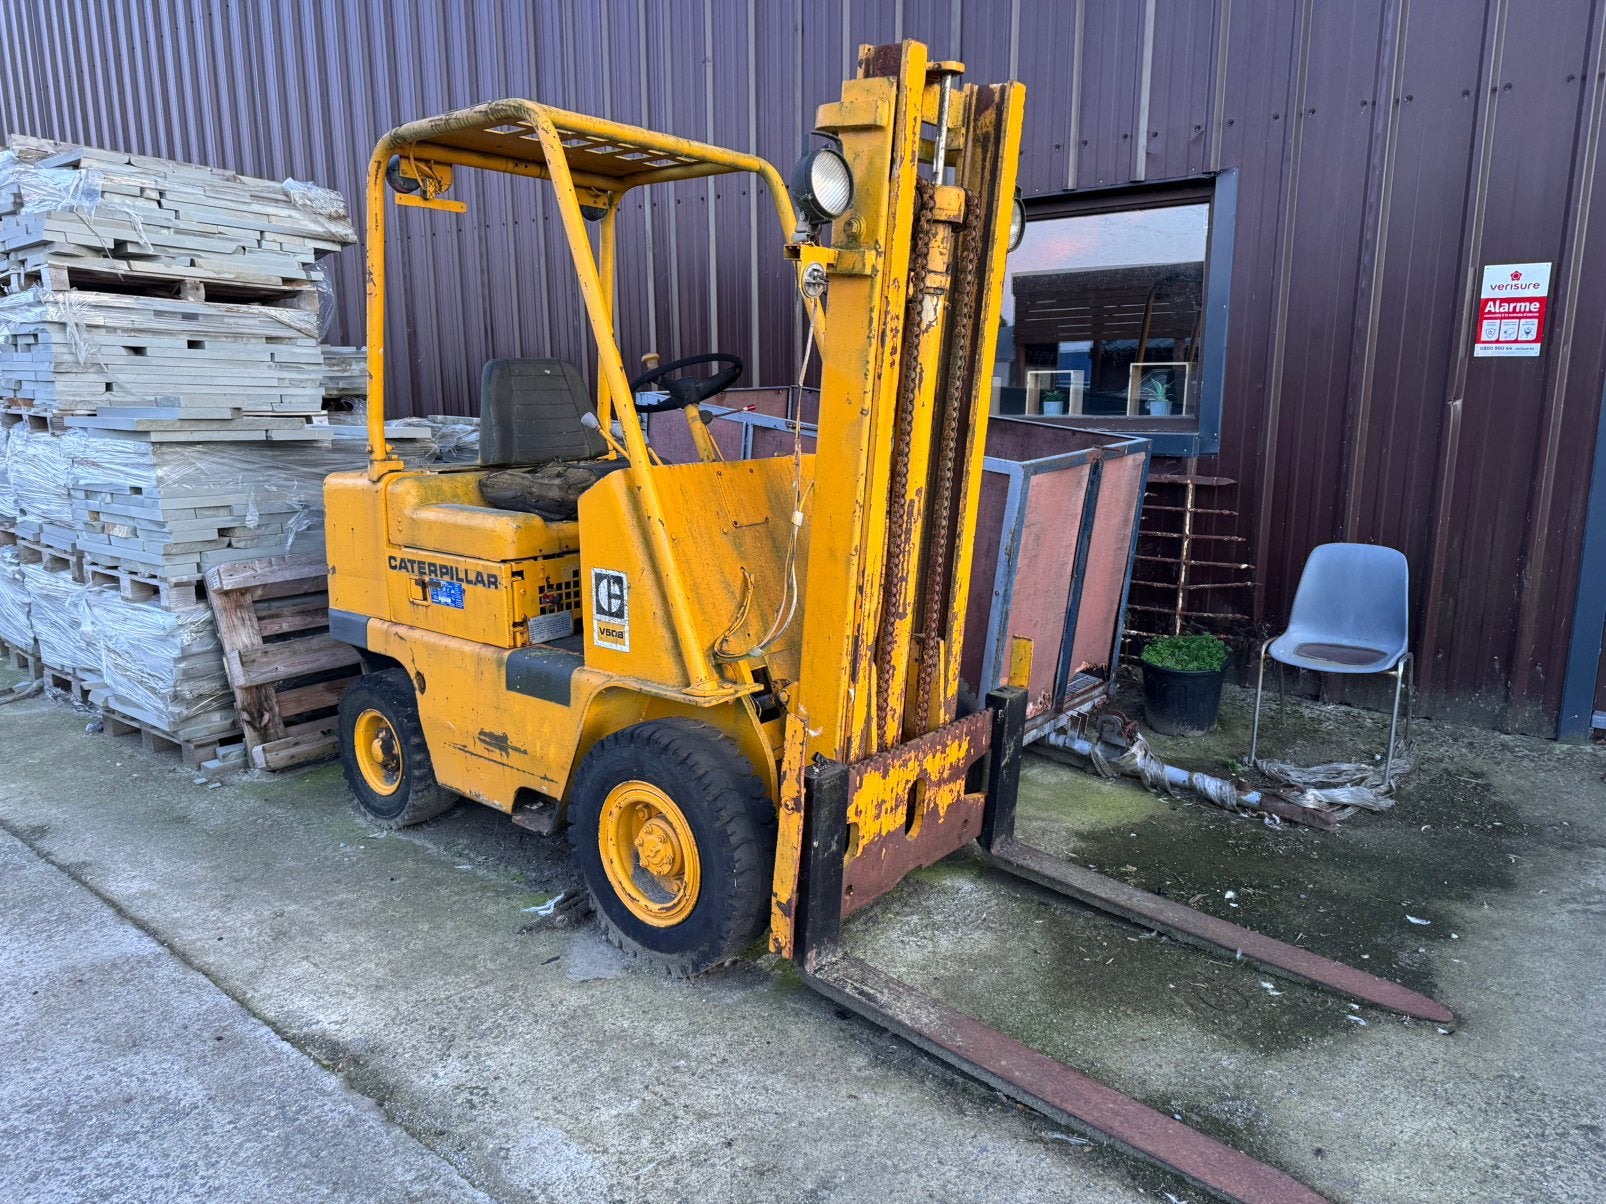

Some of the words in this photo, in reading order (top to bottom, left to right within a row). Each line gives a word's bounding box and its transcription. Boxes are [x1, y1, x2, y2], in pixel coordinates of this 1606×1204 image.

[1490, 282, 1540, 291] verisure
[1484, 300, 1540, 312] Alarme
[388, 555, 499, 590] CATERPILLAR
